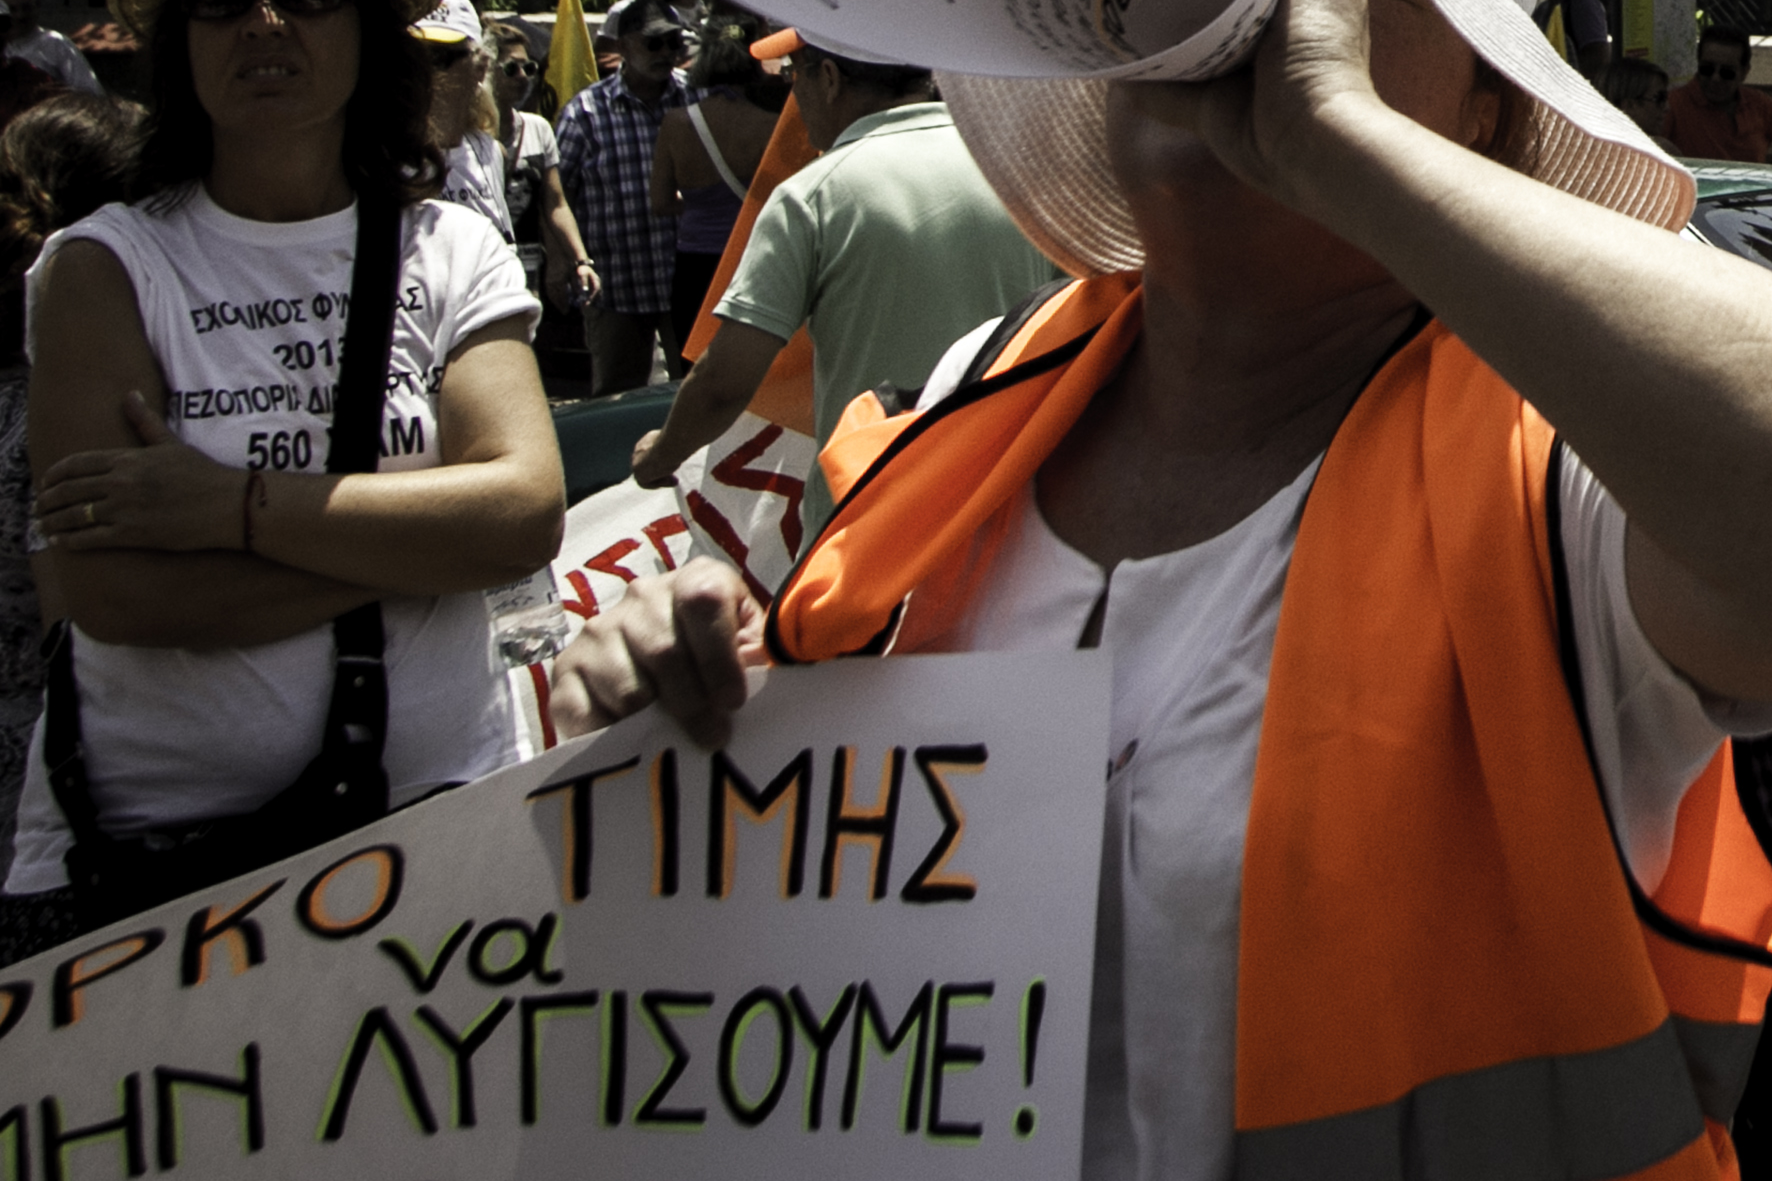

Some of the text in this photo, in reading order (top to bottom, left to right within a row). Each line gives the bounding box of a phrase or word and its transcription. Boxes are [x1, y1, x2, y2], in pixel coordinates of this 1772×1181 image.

[247, 430, 311, 470] 560
[526, 743, 989, 903] ΤΙΜΗΣ
[377, 913, 564, 994] να
